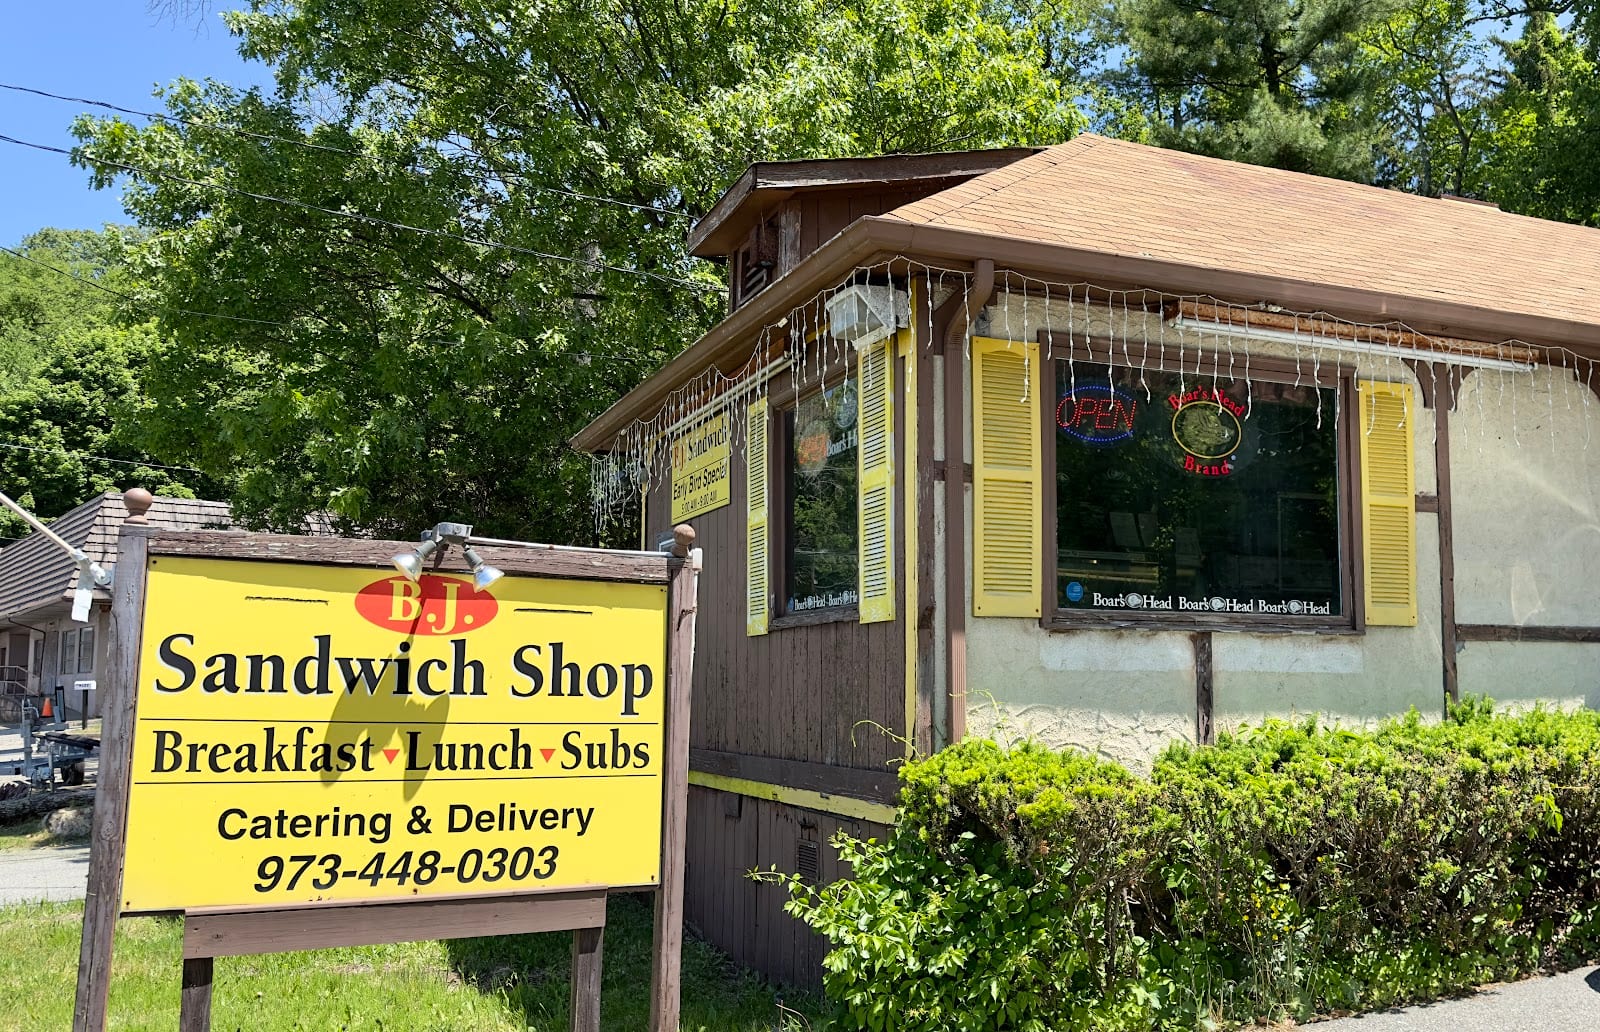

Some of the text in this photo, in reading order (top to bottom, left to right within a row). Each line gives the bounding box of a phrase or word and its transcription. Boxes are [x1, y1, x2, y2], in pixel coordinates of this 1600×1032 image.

[1056, 397, 1137, 429] OPEN
[1167, 385, 1245, 417] Boar's Head
[688, 417, 727, 461] Sandwich
[673, 460, 728, 501] Early Bird Special
[1184, 455, 1230, 475] Brand
[388, 580, 474, 634] B.J.
[1093, 592, 1126, 607] Boar's
[1143, 595, 1172, 609] Head
[1178, 596, 1254, 612] Boar's Head
[1258, 600, 1330, 615] Boar's Head
[154, 633, 653, 716] Sandwich Shop
[151, 726, 650, 773] Breakfast Lunch Subs
[217, 803, 595, 843] Catering & Delivery
[254, 845, 559, 893] 973-448-0303
